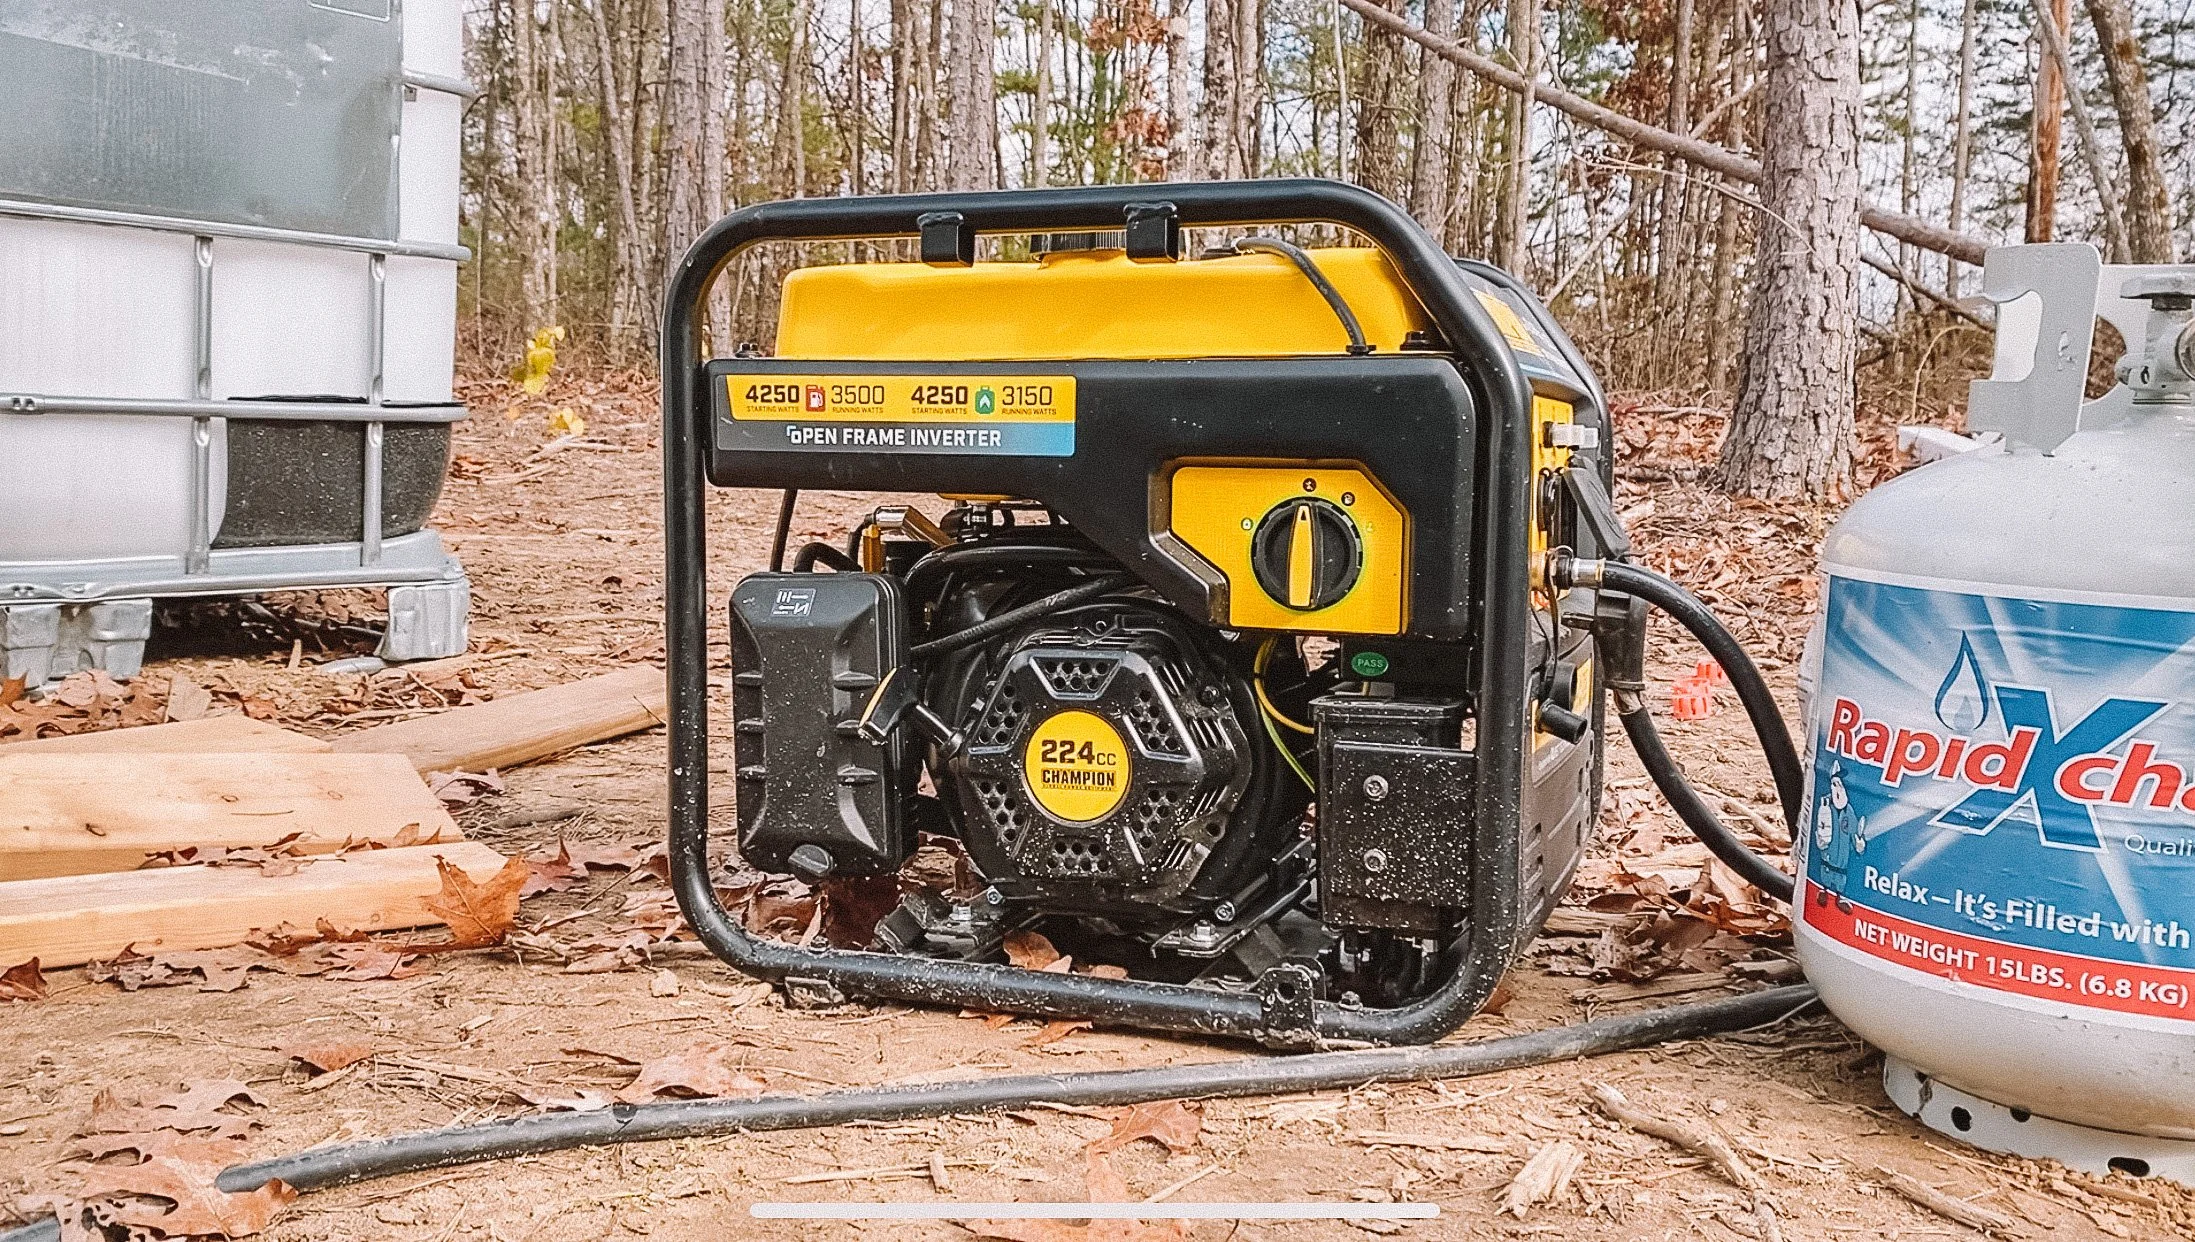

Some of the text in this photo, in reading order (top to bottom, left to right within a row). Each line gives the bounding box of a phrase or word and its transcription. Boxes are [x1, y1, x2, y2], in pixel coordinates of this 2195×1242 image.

[745, 385, 800, 403] 4250
[831, 385, 884, 405] 3500
[911, 385, 968, 405] 4250
[1002, 386, 1053, 406] 3150
[911, 407, 968, 415] STARTING WATTS
[1001, 408, 1057, 416] RUNNING WATTS
[788, 426, 1001, 447] OPEN FRAME INVERTER
[1357, 658, 1384, 668] PASS
[1828, 699, 2037, 790] Rapid
[1042, 769, 1115, 786] CHAMPION
[2006, 899, 2101, 938] Filled
[2110, 919, 2190, 949] with
[1854, 918, 2189, 1009] NET WEIGHT 15LBS. (6.8 KG)
